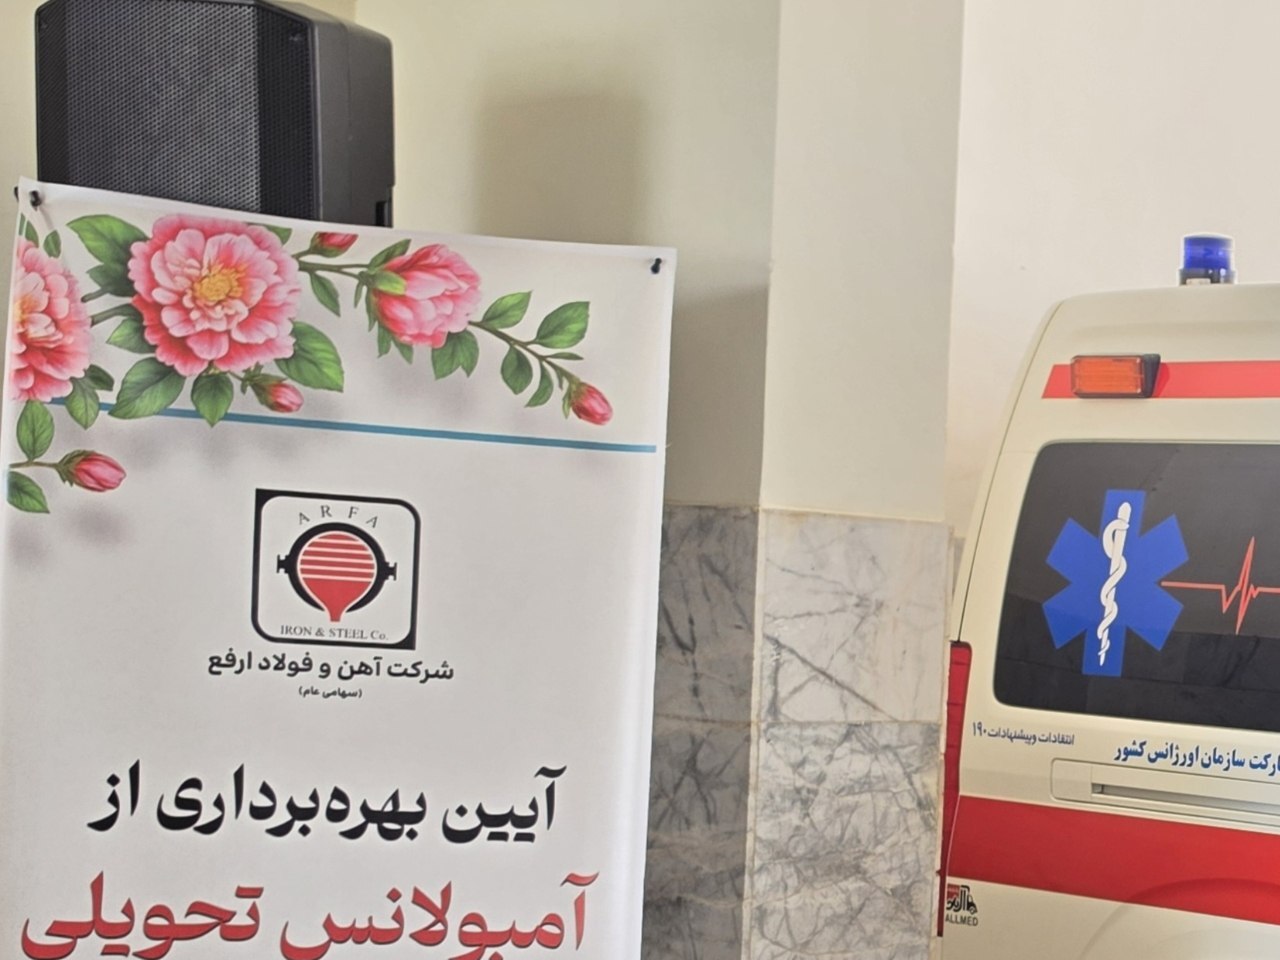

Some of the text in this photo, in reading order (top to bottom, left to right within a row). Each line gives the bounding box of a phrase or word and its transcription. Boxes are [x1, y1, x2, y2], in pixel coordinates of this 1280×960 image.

[280, 624, 389, 641] IRON & STEEL Co.
[208, 647, 454, 684] شرکت آهن و فولاد ارفع
[1114, 739, 1146, 762] کشور
[1147, 743, 1200, 768] اورژانس
[1201, 748, 1246, 772] سازمان
[87, 759, 141, 832] از
[442, 765, 567, 844] آیین
[945, 914, 979, 927] ALLMED
